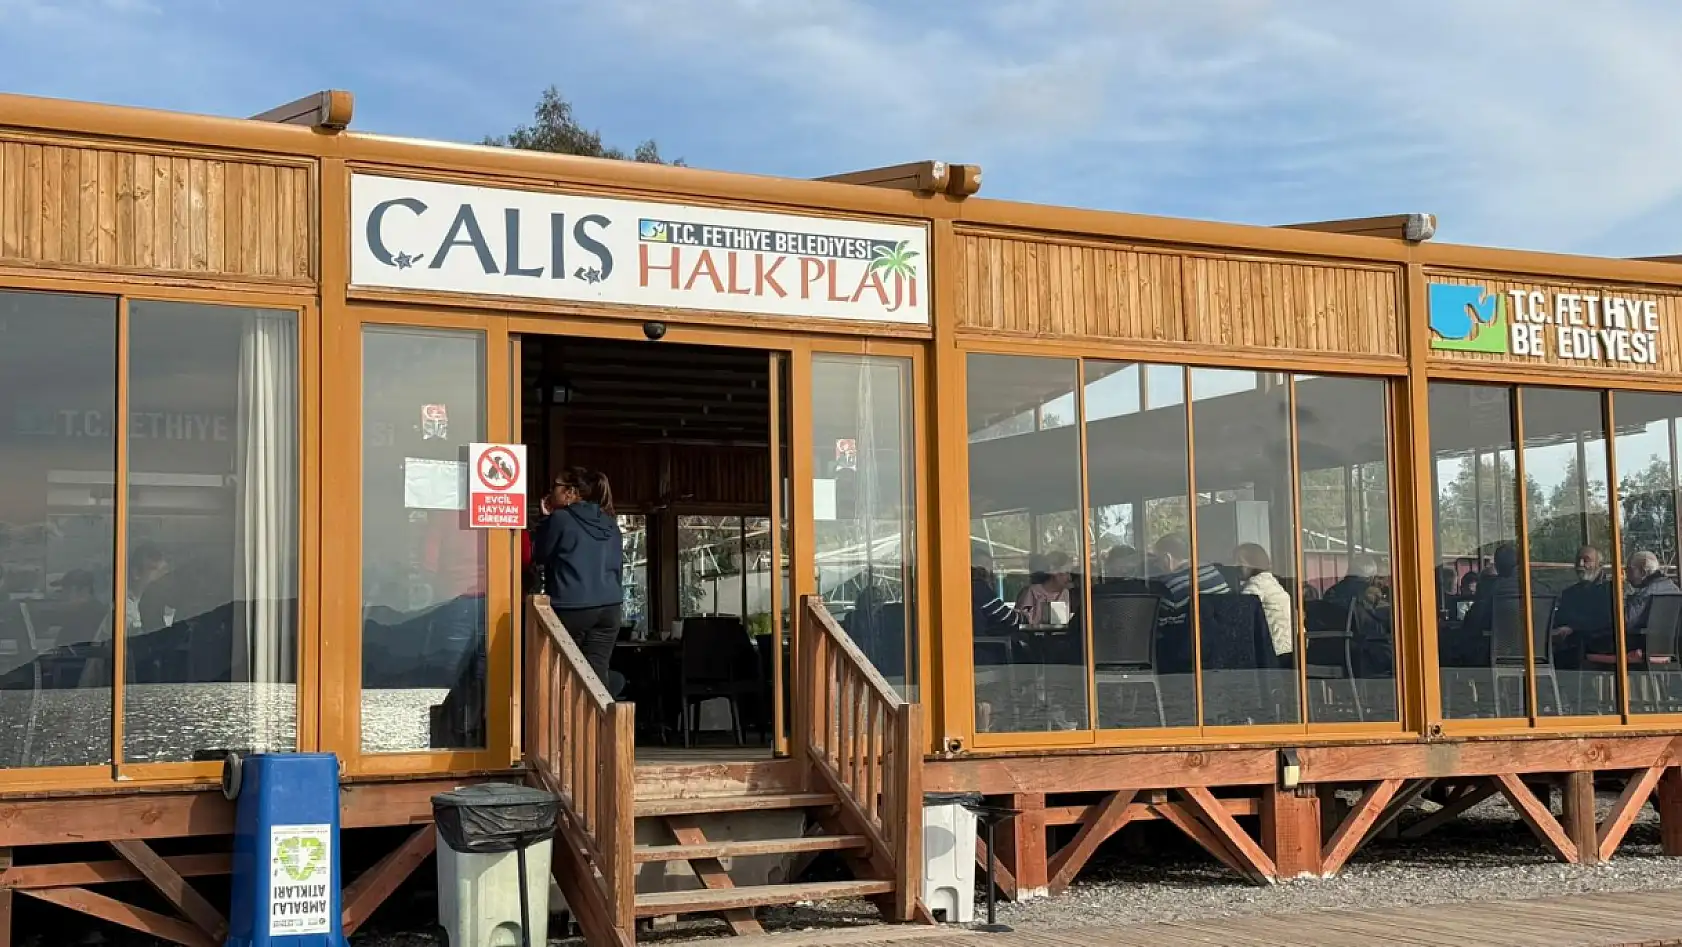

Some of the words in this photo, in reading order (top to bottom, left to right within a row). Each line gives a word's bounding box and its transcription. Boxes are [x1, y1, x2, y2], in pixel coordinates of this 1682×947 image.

[669, 222, 699, 245] T.C.
[639, 243, 788, 298] HALK
[1508, 289, 1552, 325] T.C.
[477, 504, 519, 514] HAYVAN
[274, 884, 326, 900] ATIKLARI
[273, 899, 327, 916] AMBALAJ
